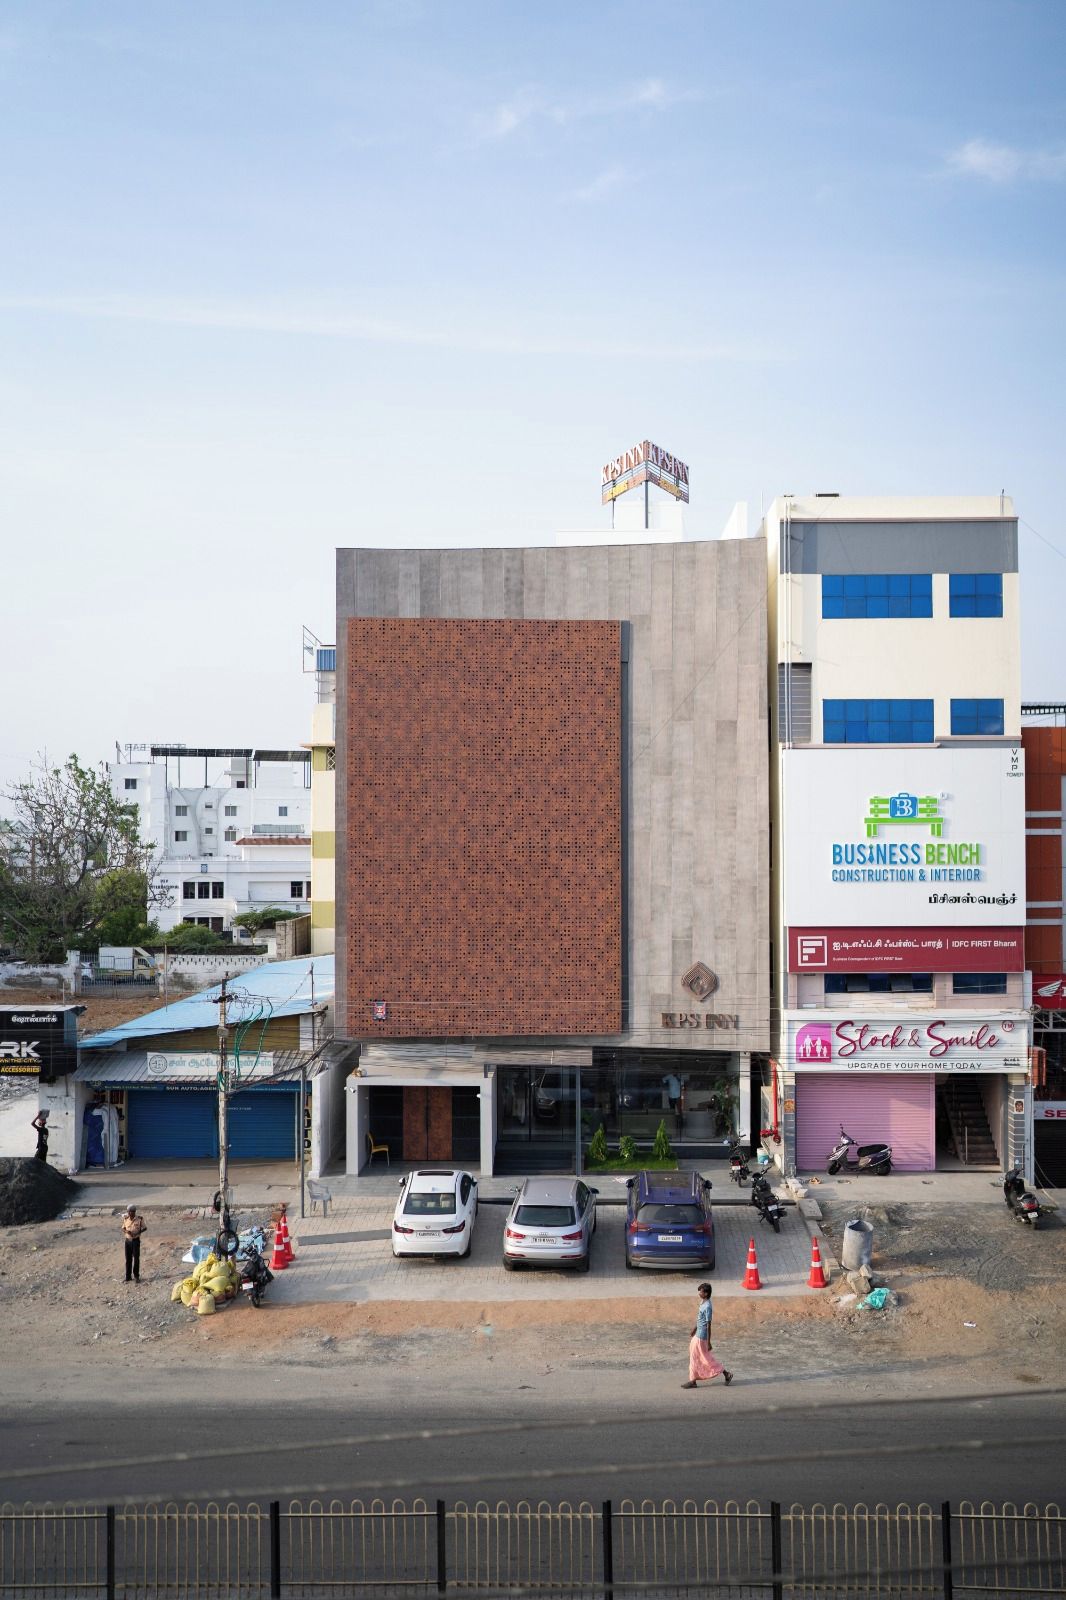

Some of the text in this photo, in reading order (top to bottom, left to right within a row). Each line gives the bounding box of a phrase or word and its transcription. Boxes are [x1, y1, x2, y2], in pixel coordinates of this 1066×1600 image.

[832, 843, 980, 865] BUSINESS BENCH
[831, 869, 981, 881] CONSTRUCTION & INTERIOR
[835, 1020, 999, 1057] Stock & Smile
